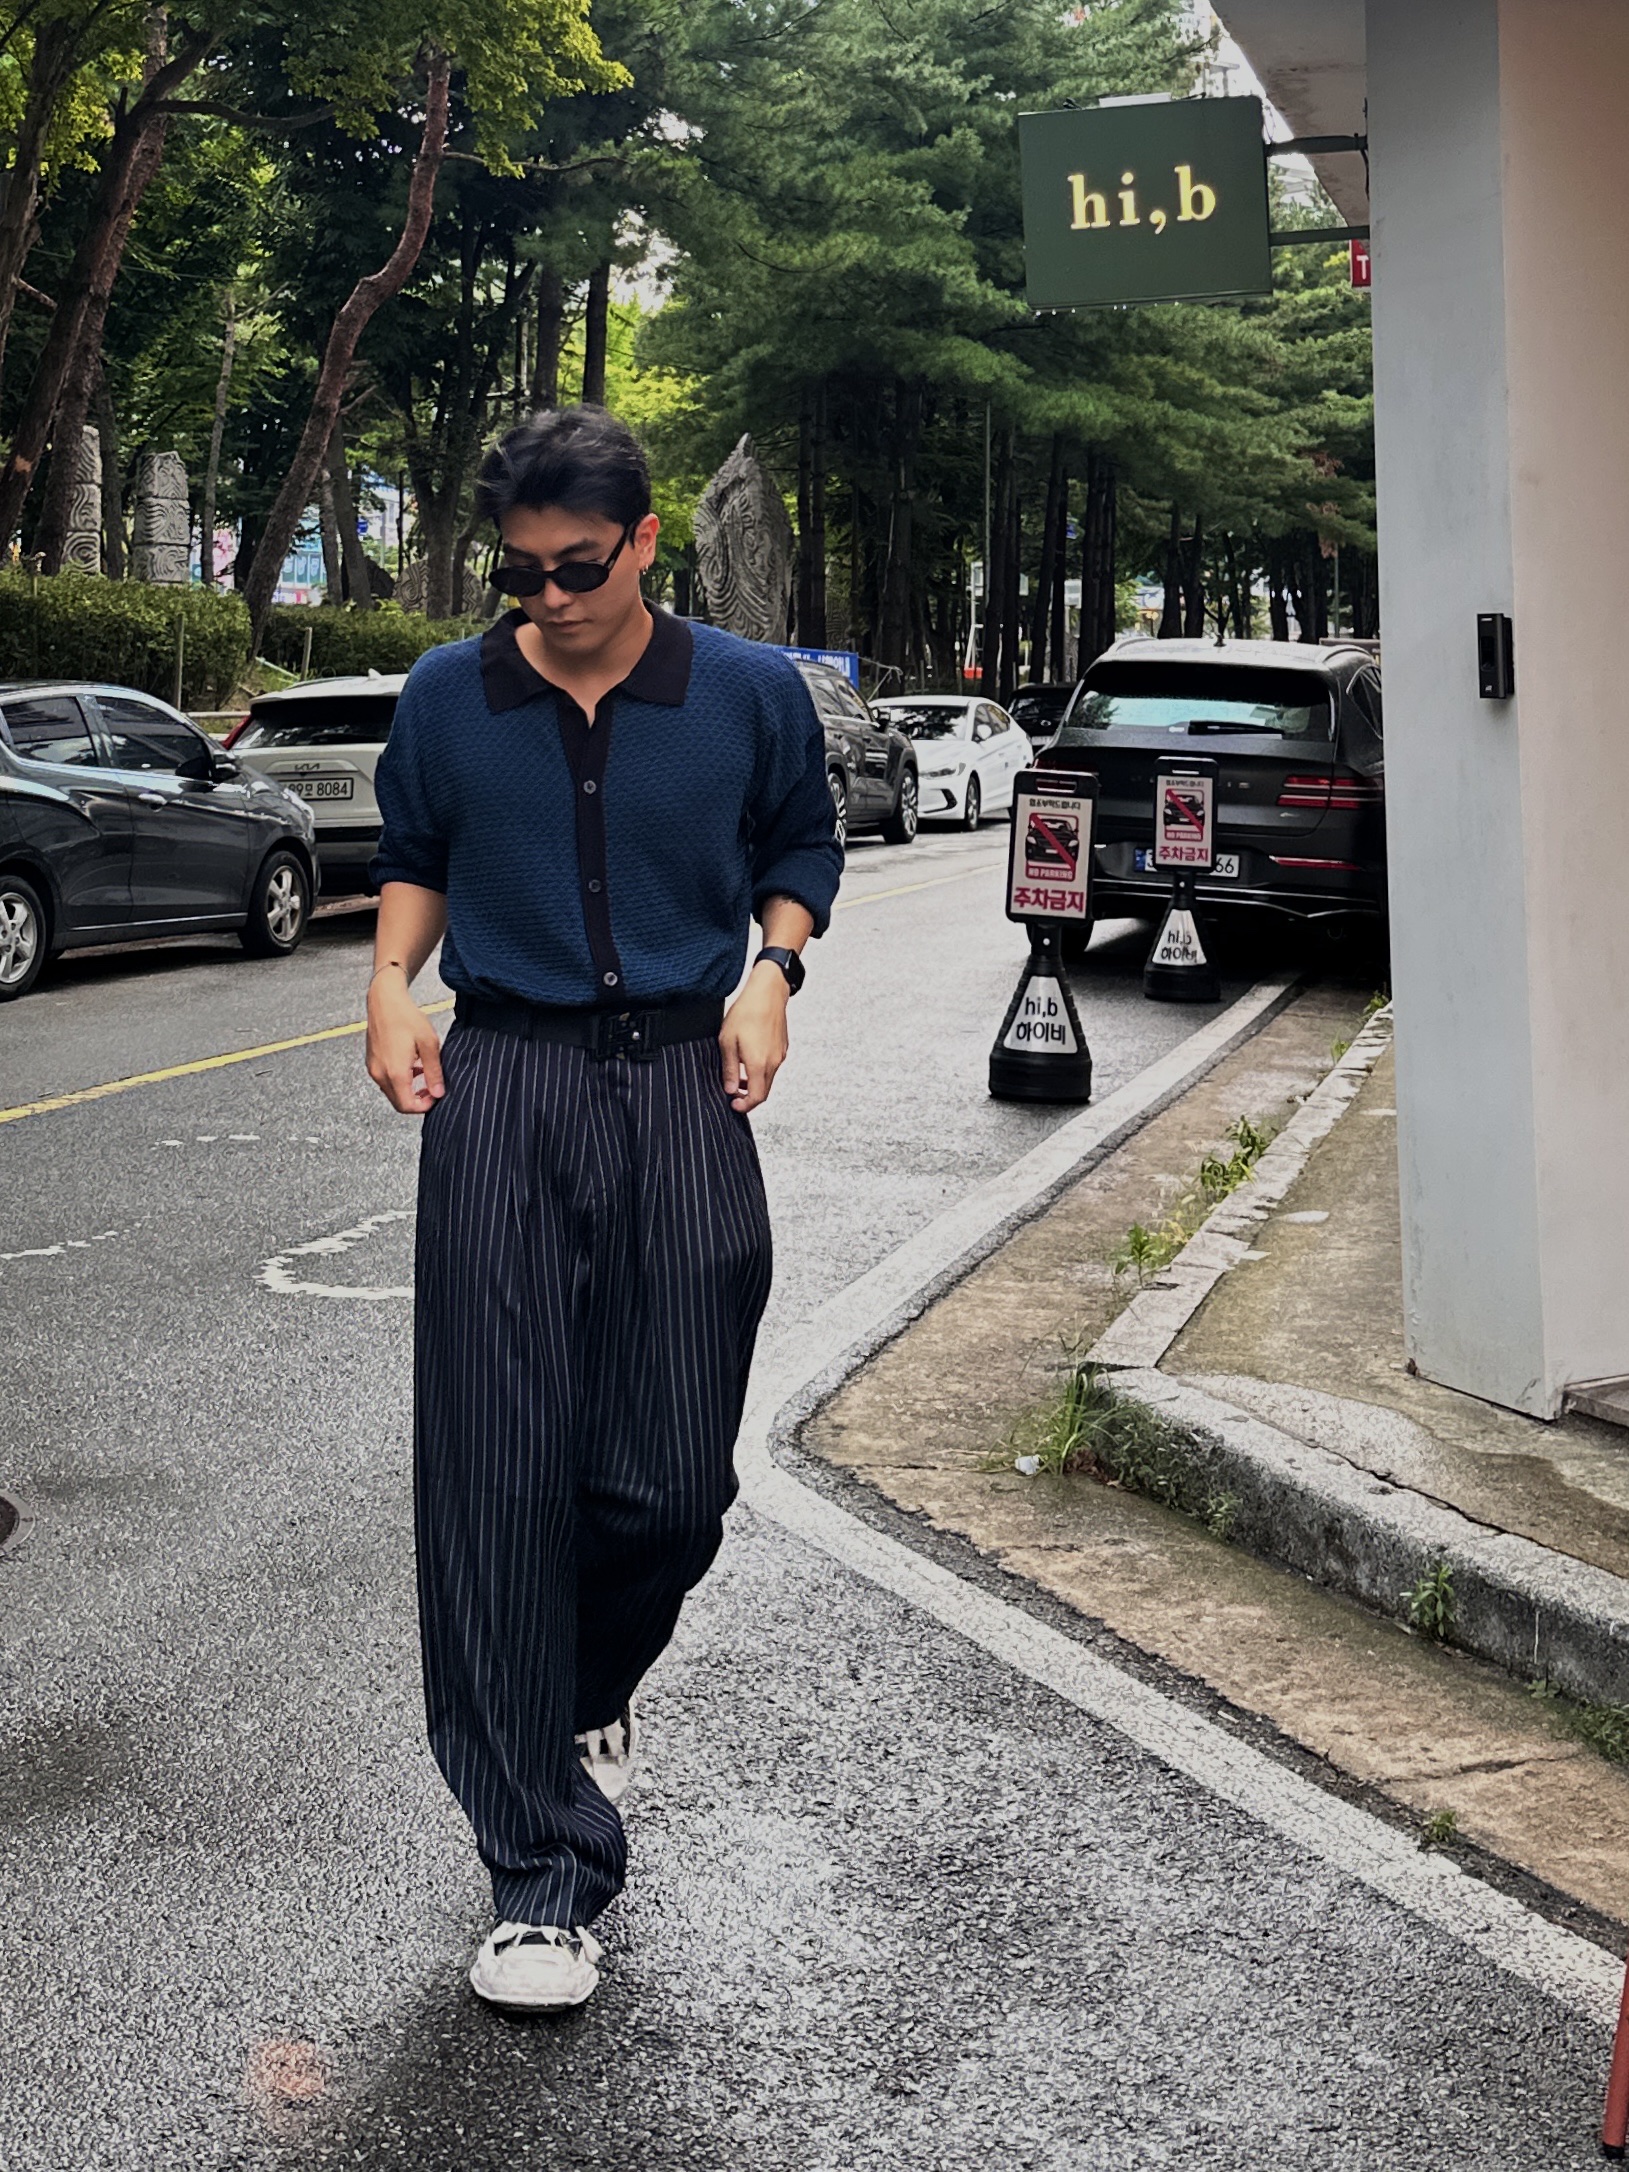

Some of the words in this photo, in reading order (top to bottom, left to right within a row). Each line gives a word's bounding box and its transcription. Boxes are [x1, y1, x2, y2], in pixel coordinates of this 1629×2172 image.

[1068, 165, 1216, 234] hi,b
[317, 782, 347, 796] 8084
[1159, 846, 1208, 862] 주차금지
[1013, 887, 1084, 913] 주차금지
[1025, 997, 1058, 1018] hi,b
[1016, 1022, 1066, 1045] 하이비
